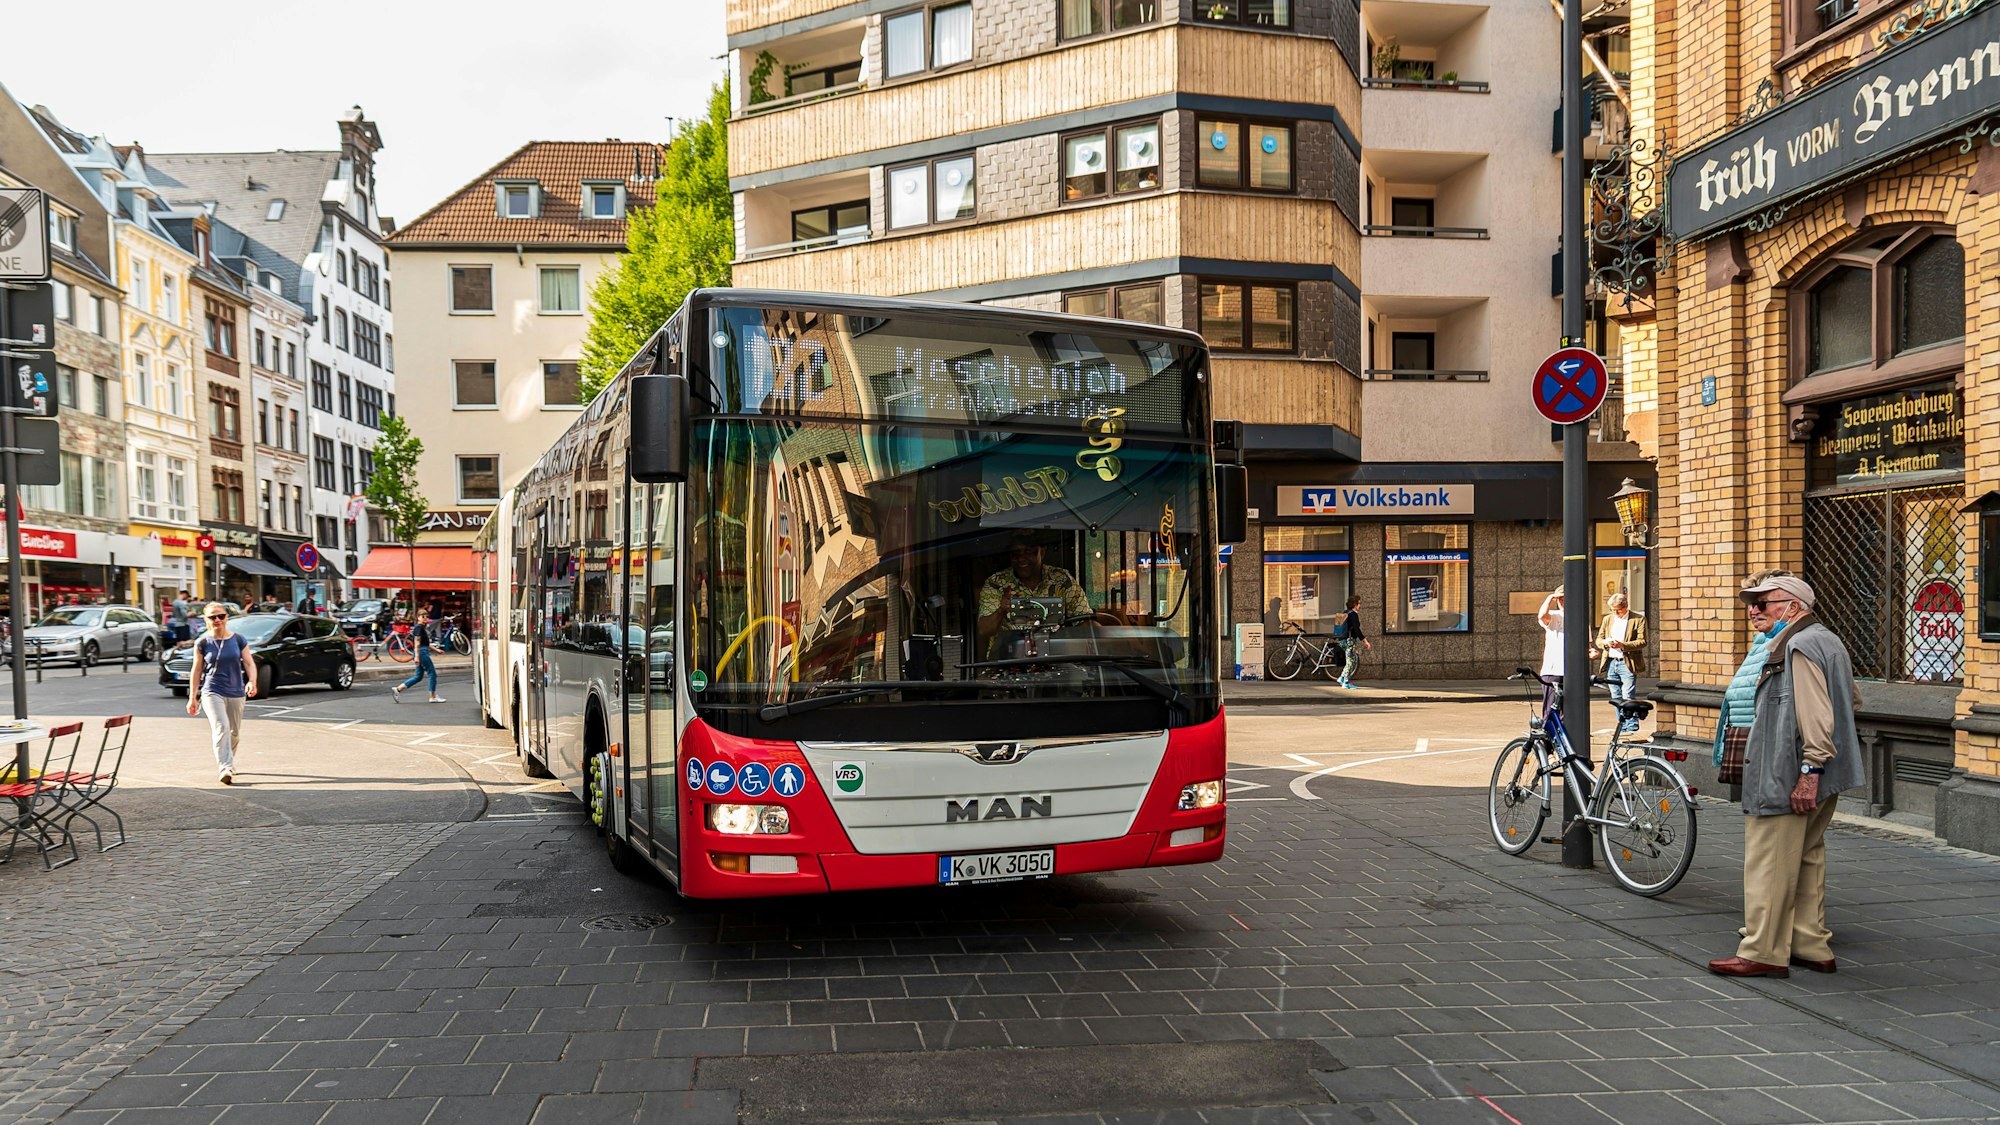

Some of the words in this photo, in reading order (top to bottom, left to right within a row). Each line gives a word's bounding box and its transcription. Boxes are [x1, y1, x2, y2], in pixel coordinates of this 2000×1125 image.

[1696, 136, 1778, 212] früh
[1787, 118, 1840, 168] VORM
[896, 346, 1126, 394] Meschenich
[1843, 392, 1953, 428] Severinstorburg
[1342, 487, 1450, 507] Volksbank
[835, 770, 856, 779] VRS
[945, 794, 1052, 822] MAN
[953, 859, 965, 878] K
[978, 856, 1002, 876] VK
[1006, 853, 1051, 874] 3050
